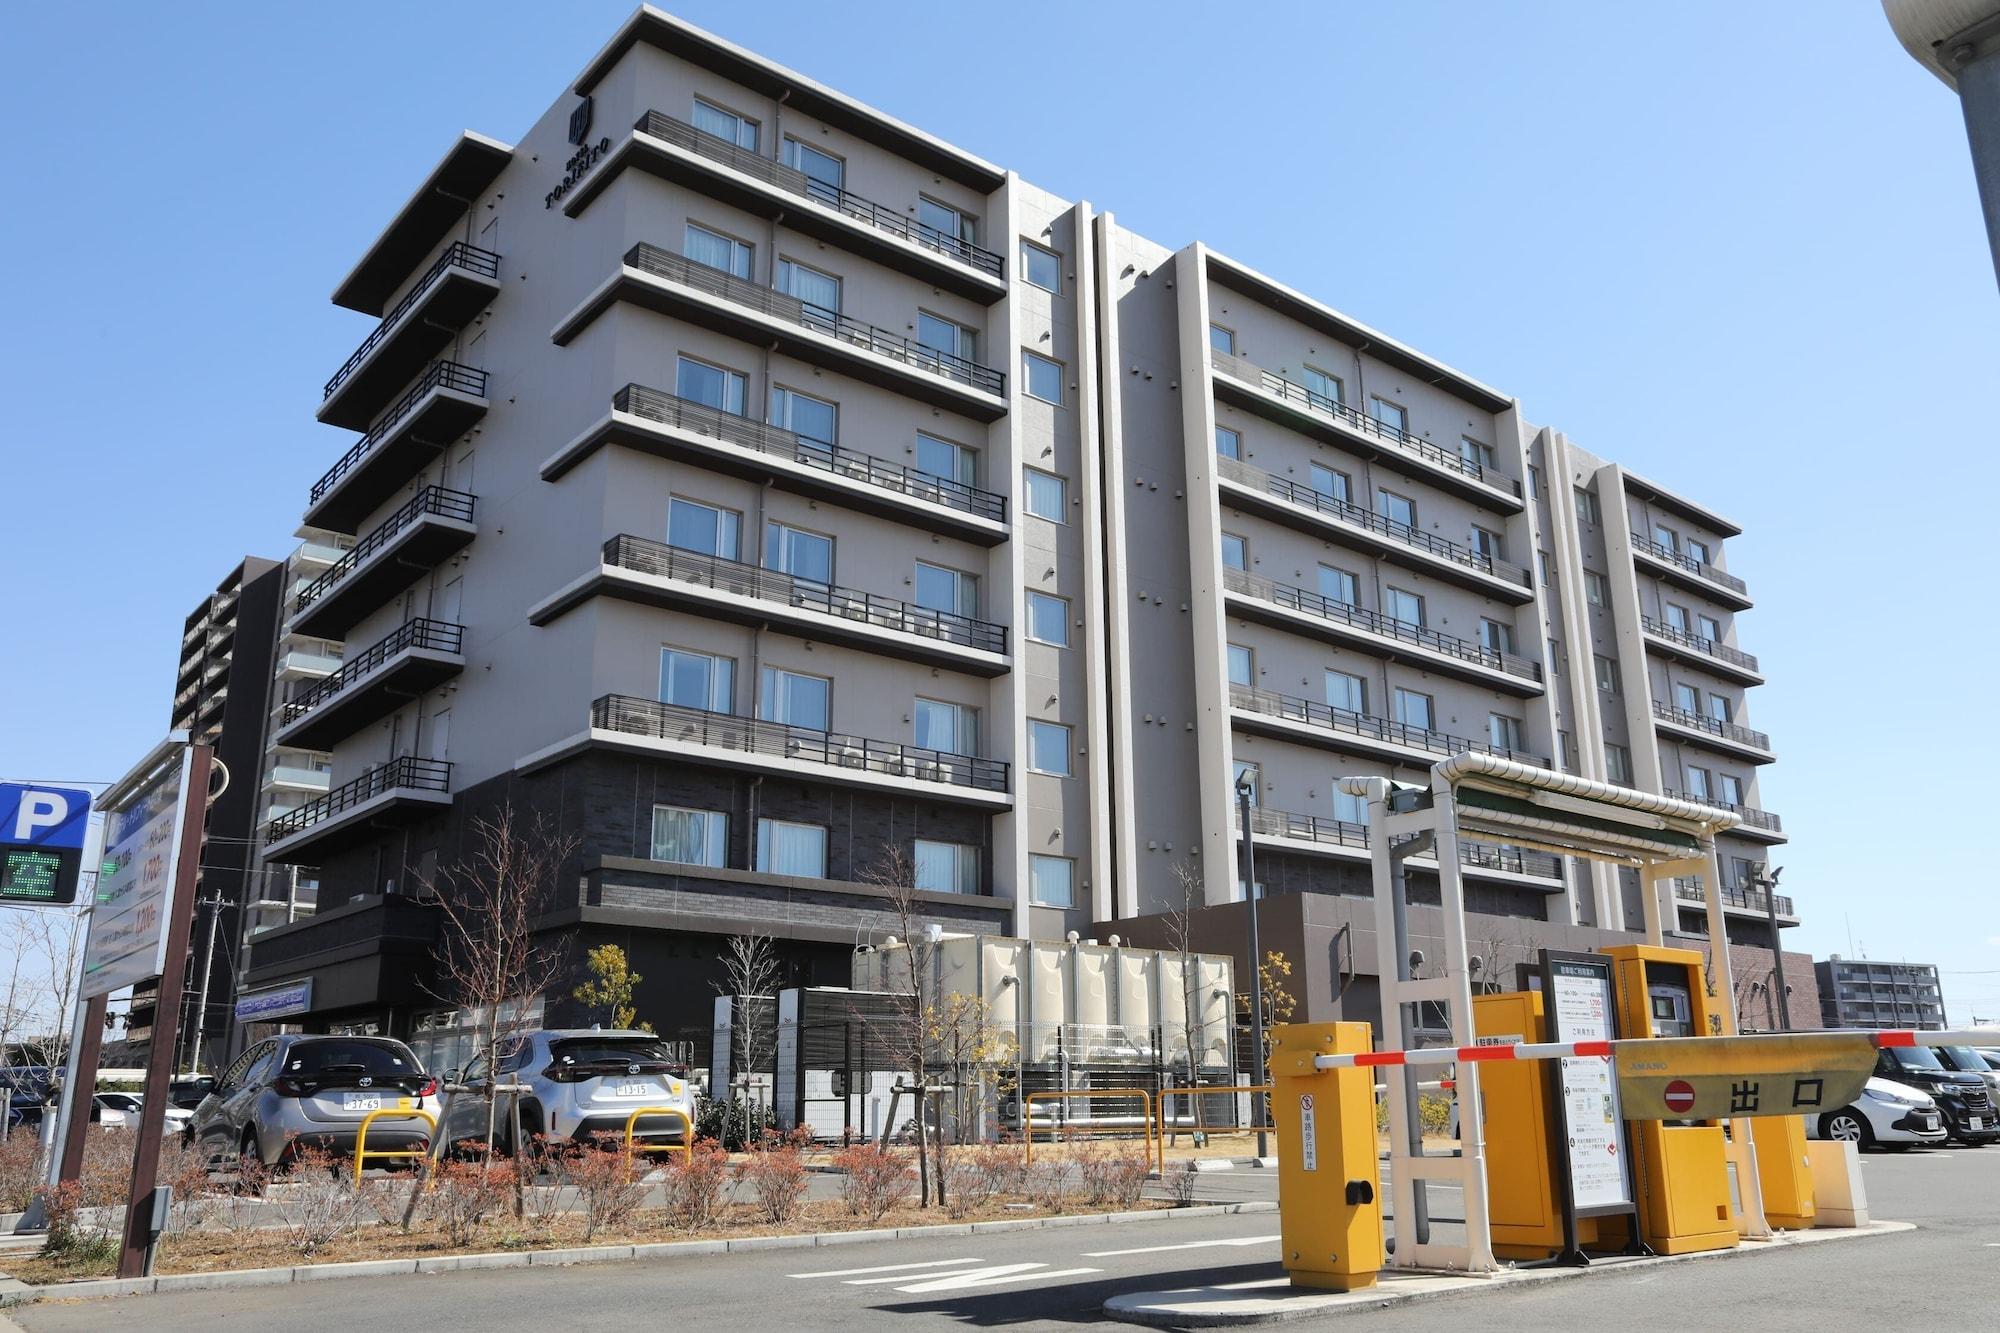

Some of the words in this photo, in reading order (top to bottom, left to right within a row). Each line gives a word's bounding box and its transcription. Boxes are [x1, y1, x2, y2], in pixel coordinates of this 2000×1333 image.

[14, 790, 68, 840] P
[3, 851, 61, 897] 空
[1730, 1078, 1824, 1113] 出口
[1304, 1113, 1313, 1169] 車路歩行禁止
